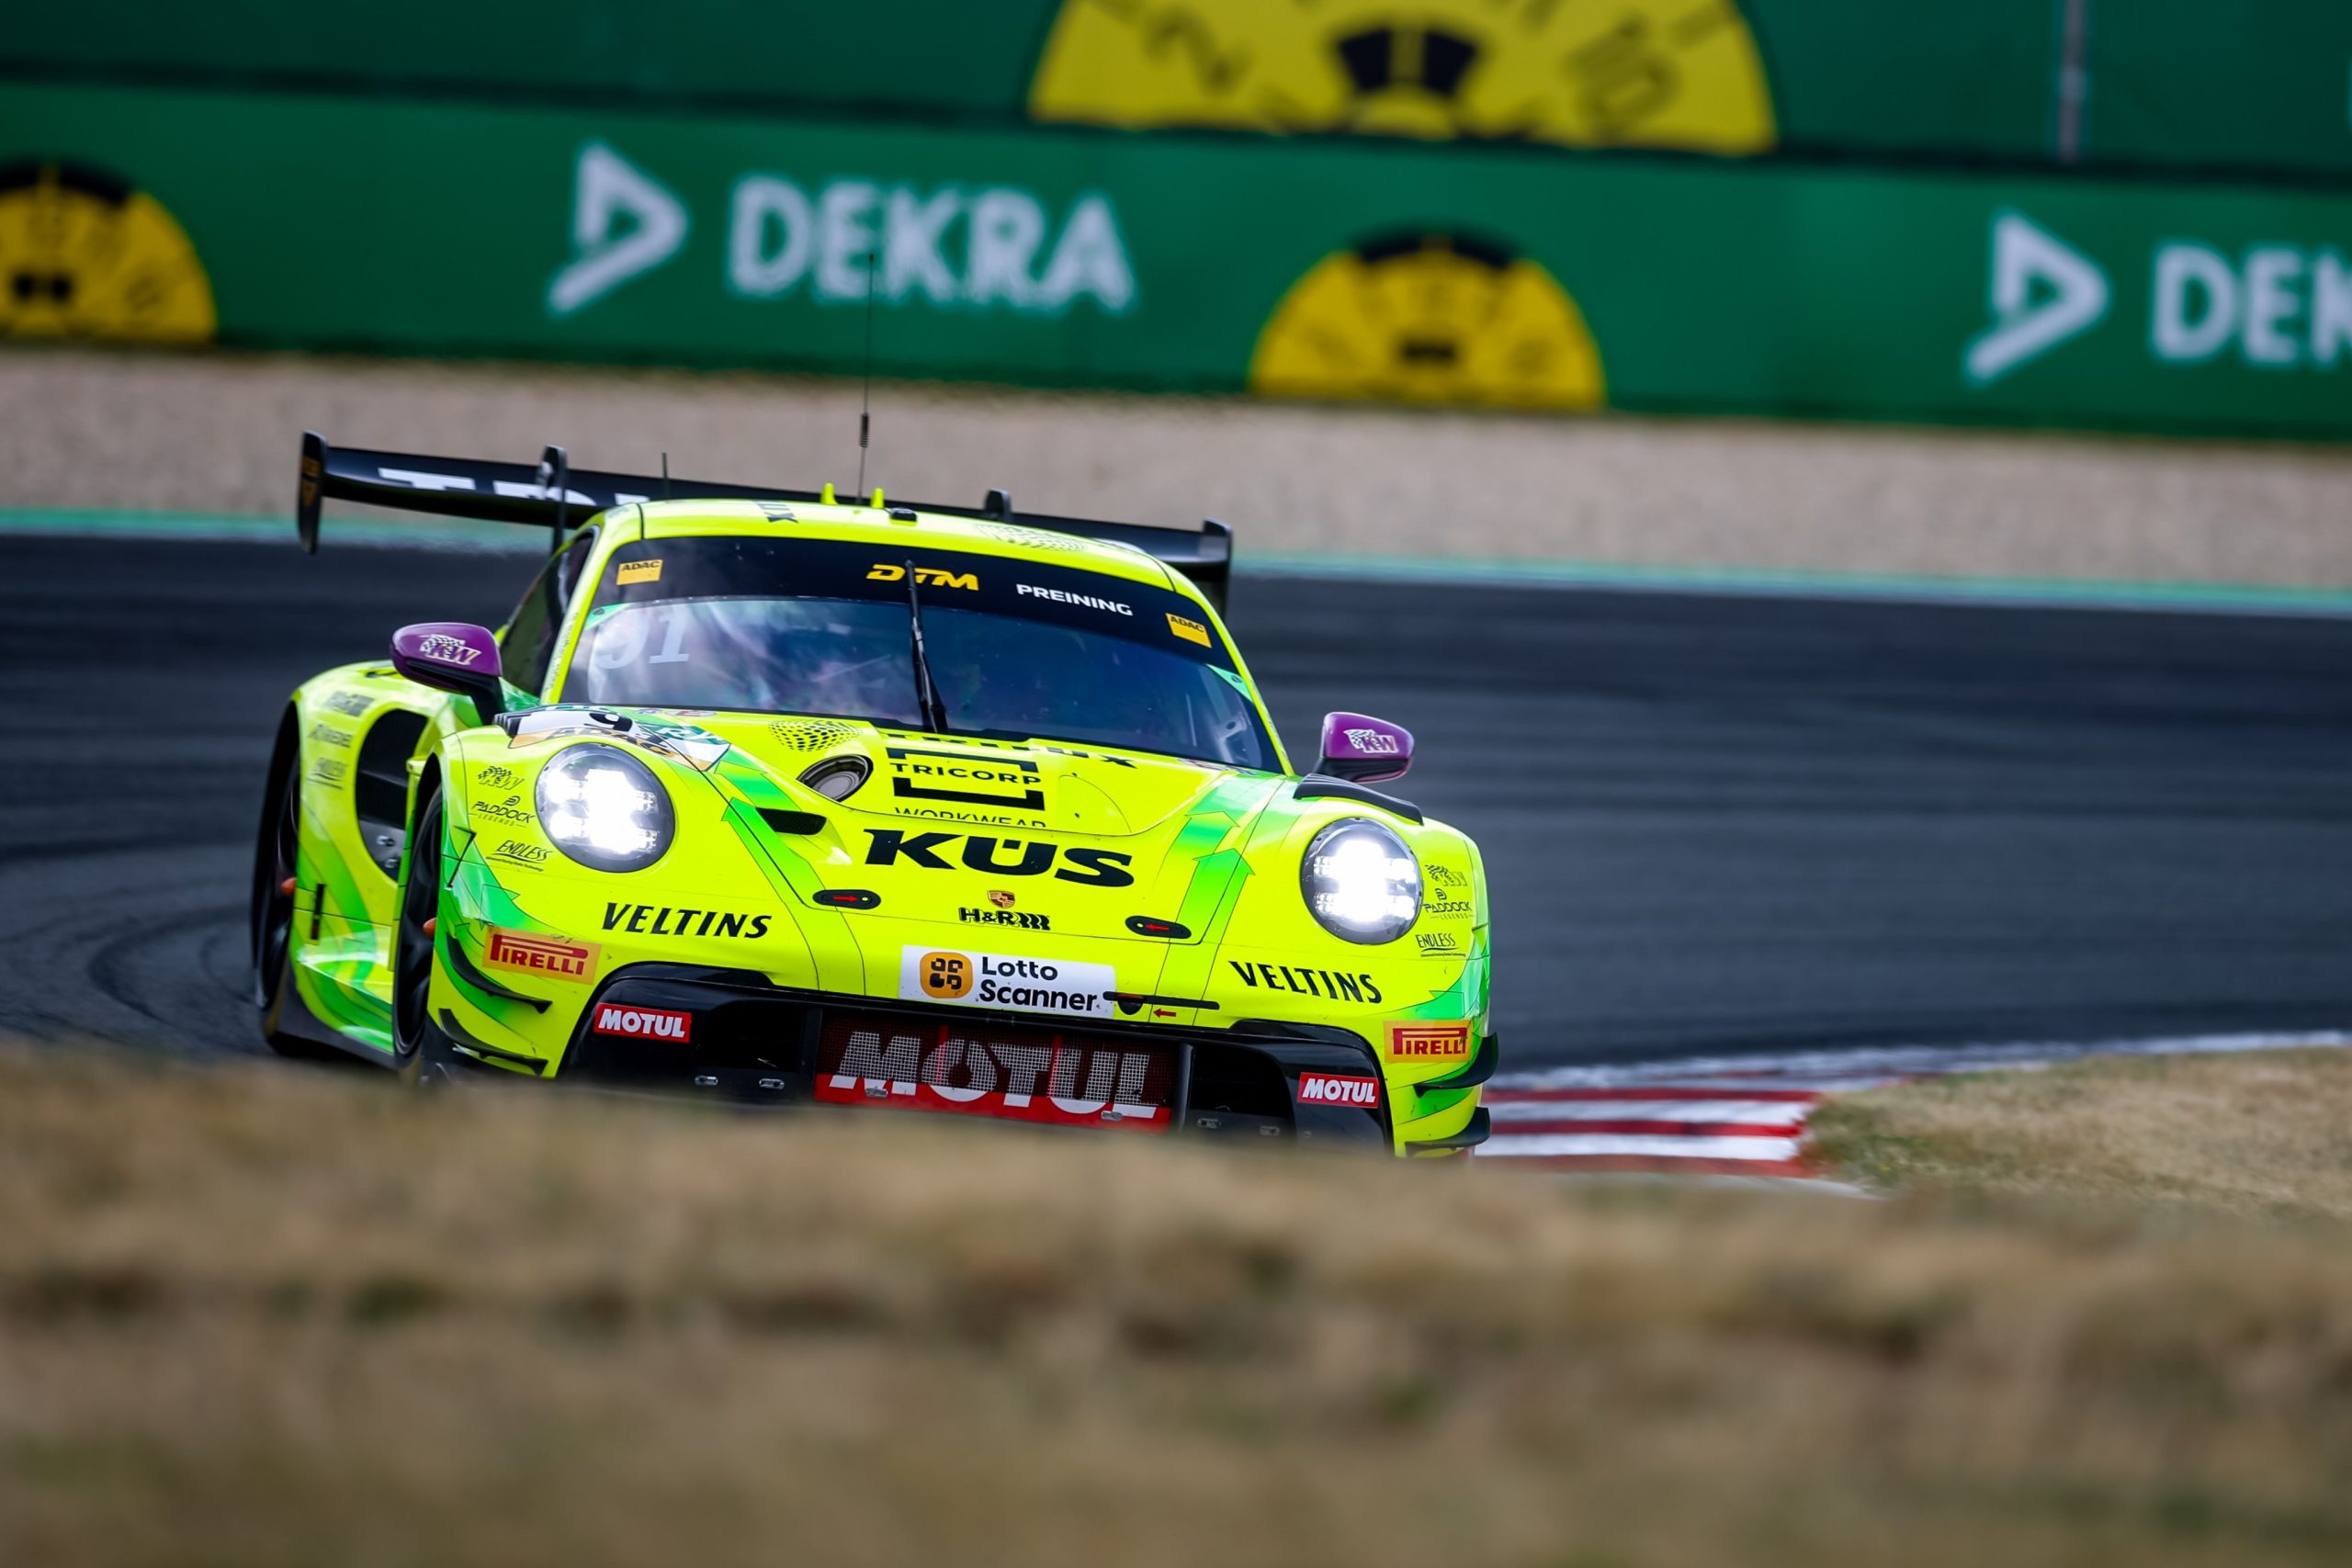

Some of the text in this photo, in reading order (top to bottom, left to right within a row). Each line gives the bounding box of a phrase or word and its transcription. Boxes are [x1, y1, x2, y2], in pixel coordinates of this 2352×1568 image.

[730, 177, 1133, 312] DEKRA
[621, 561, 661, 571] ADAC
[865, 563, 980, 591] DTM
[1016, 583, 1134, 616] PREINING
[889, 761, 1042, 785] TRICORP
[471, 801, 536, 823] PADDOCK
[496, 840, 553, 862] ENDLESS
[864, 829, 1135, 887] KÜS
[601, 902, 772, 939] VELTINS
[1423, 902, 1473, 914] PADDOCK
[490, 933, 589, 976] PIRELLI
[1416, 933, 1456, 948] ENDLESS
[982, 956, 1058, 981] Lotto
[1228, 961, 1383, 1003] VELTINS
[979, 979, 1098, 1011] Scanner
[598, 1009, 685, 1038] MOTUL
[1392, 1027, 1468, 1056] PIRELLI
[830, 1031, 1157, 1118] MOTUL
[1301, 1078, 1376, 1103] MOTUL
